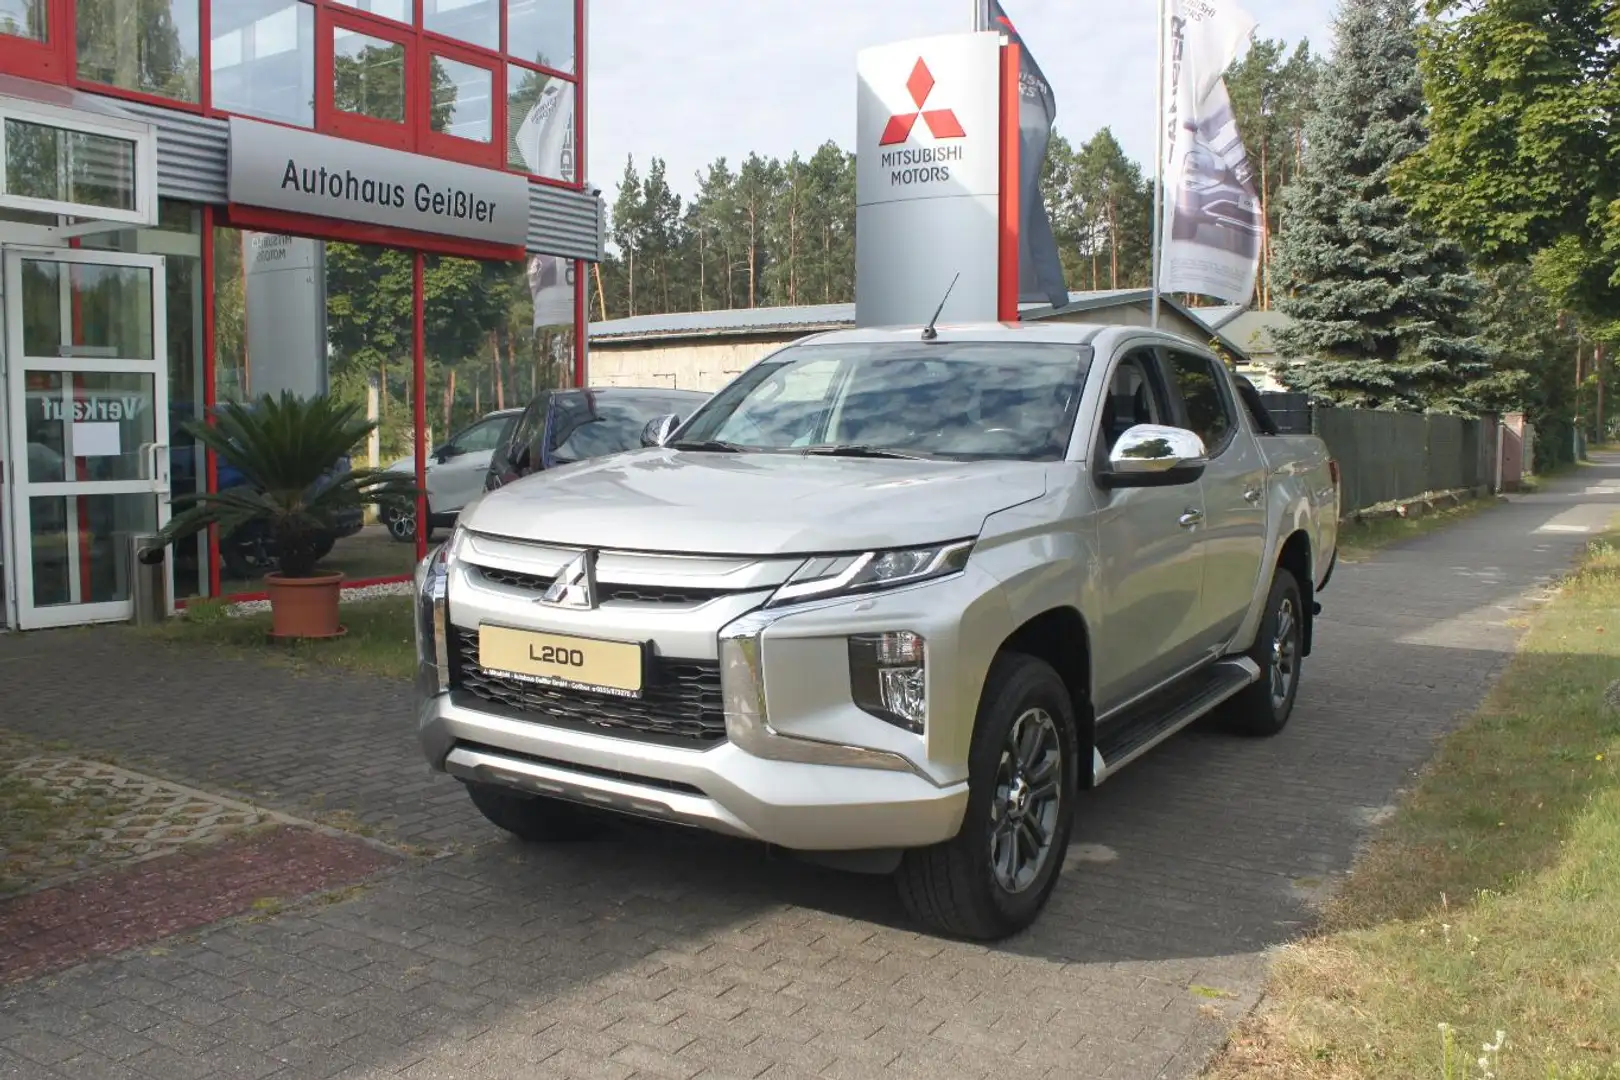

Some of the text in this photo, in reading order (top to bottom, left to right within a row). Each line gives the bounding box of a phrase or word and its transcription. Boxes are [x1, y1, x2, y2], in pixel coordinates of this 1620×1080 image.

[881, 145, 963, 168] MITSUBISHI
[891, 166, 950, 186] MOTORS
[281, 159, 497, 223] Autohaus Geißler
[529, 643, 584, 667] L200
